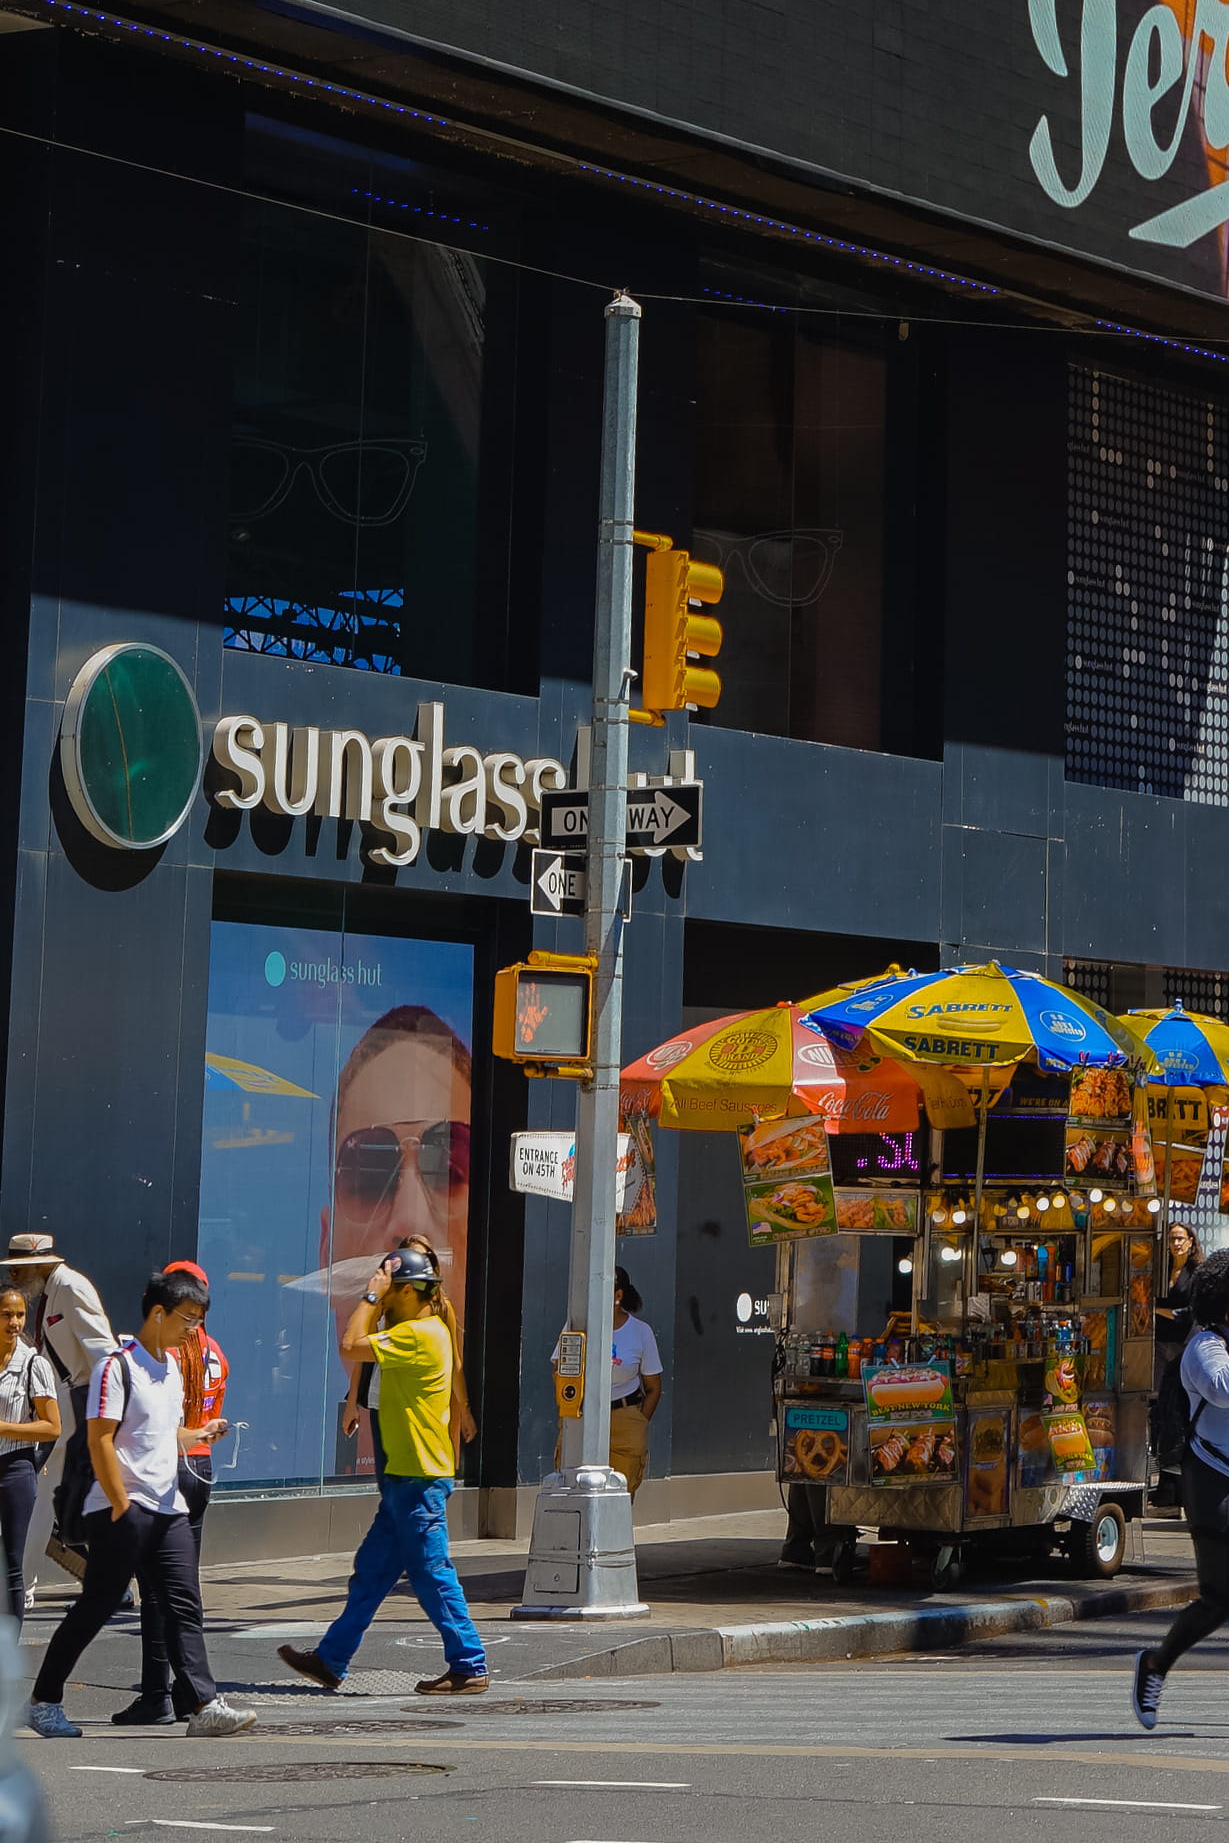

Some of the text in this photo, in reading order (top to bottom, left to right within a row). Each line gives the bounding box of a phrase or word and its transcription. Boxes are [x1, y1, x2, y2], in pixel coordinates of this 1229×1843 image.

[563, 806, 675, 833] ON WAY
[550, 872, 576, 897] ONE
[289, 956, 383, 989] sunglass hut
[906, 1002, 1014, 1020] SABRETT
[904, 1036, 1000, 1060] SABRETT
[671, 1097, 687, 1109] All
[689, 1097, 718, 1111] Beef
[519, 1147, 559, 1165] ENTRANCE
[522, 1162, 534, 1176] ON
[536, 1163, 556, 1179] 45TH
[923, 1402, 951, 1412] YORK
[793, 1414, 841, 1427] PRETZEL
